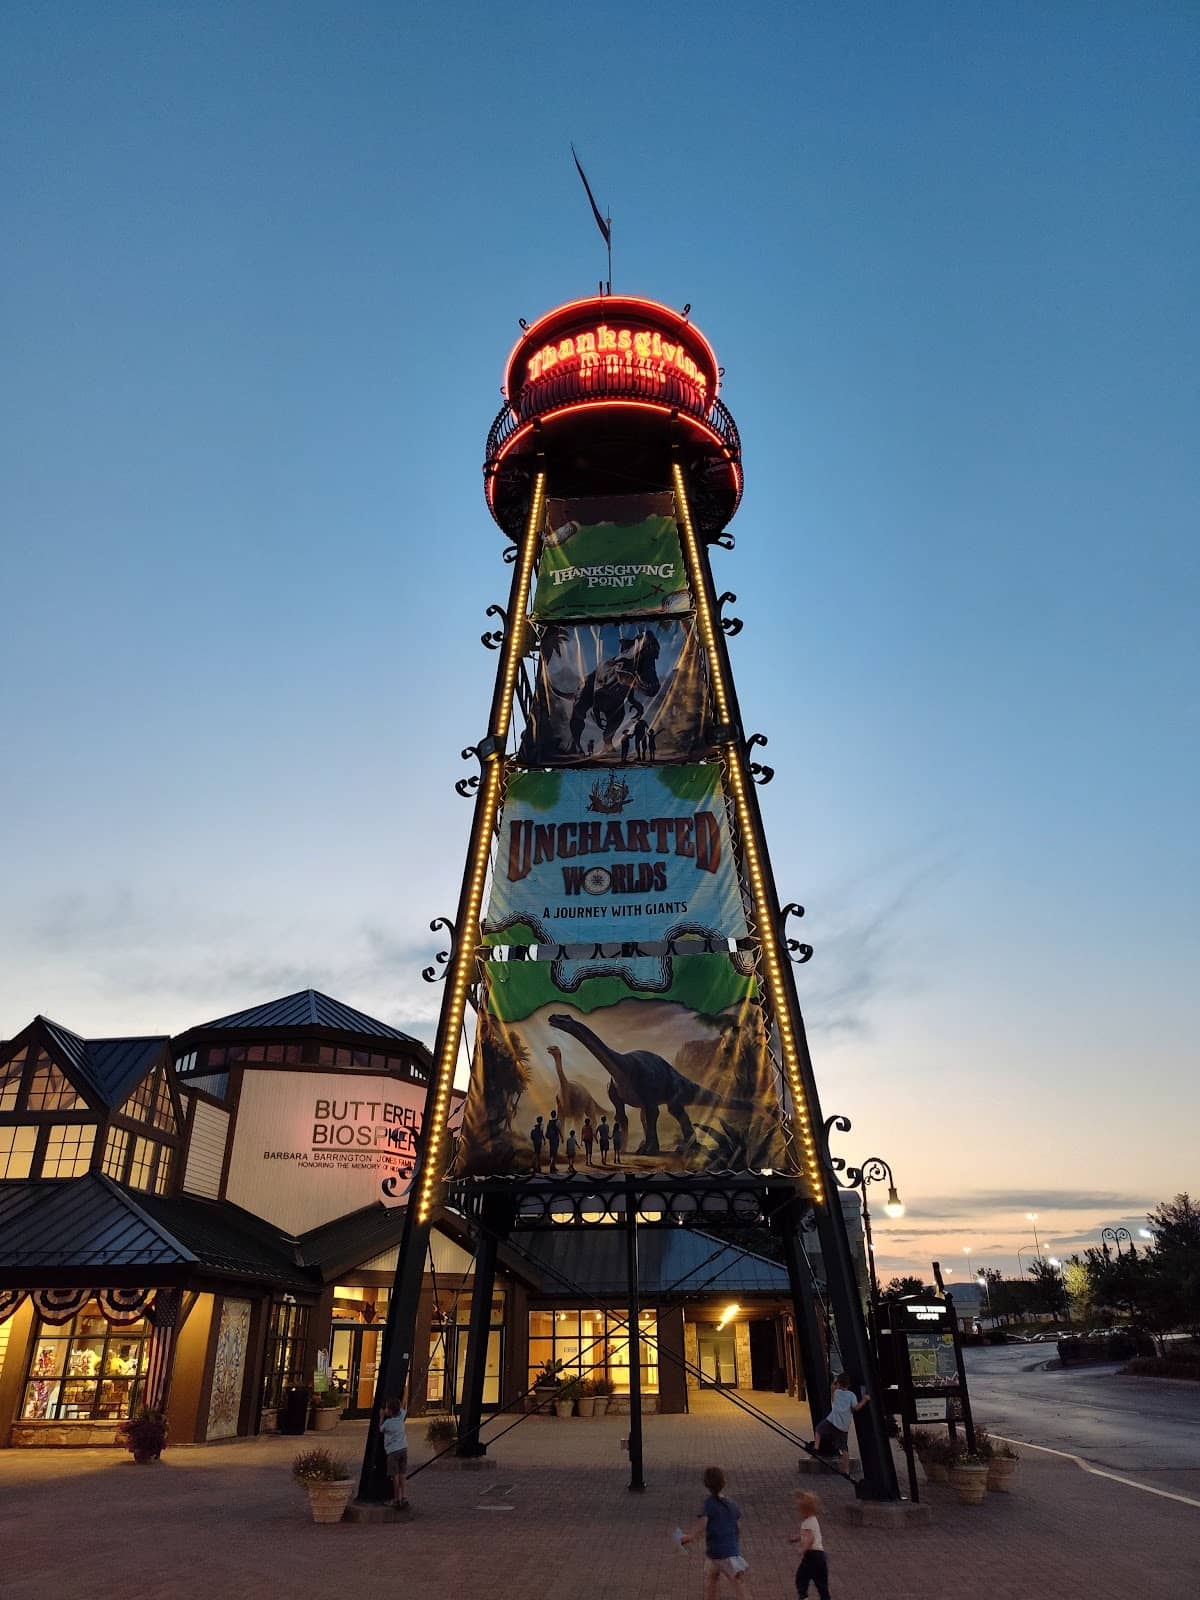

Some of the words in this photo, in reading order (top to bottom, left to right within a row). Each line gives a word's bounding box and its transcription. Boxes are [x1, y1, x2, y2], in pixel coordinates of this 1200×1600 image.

[527, 325, 707, 397] Thanksgiving
[549, 563, 676, 586] THANKSGIVING
[587, 575, 636, 588] POINT
[507, 811, 721, 882] UNCHARTED
[562, 861, 668, 896] WORLDS
[542, 907, 551, 919] A
[553, 906, 608, 919] JOURNEY
[611, 904, 641, 917] WITH
[645, 901, 688, 915] GIANTS
[312, 1124, 417, 1152] BIOSPHER
[263, 1151, 308, 1161] BARBARA
[313, 1152, 373, 1162] BARRINGTON
[297, 1161, 335, 1169] HONORING
